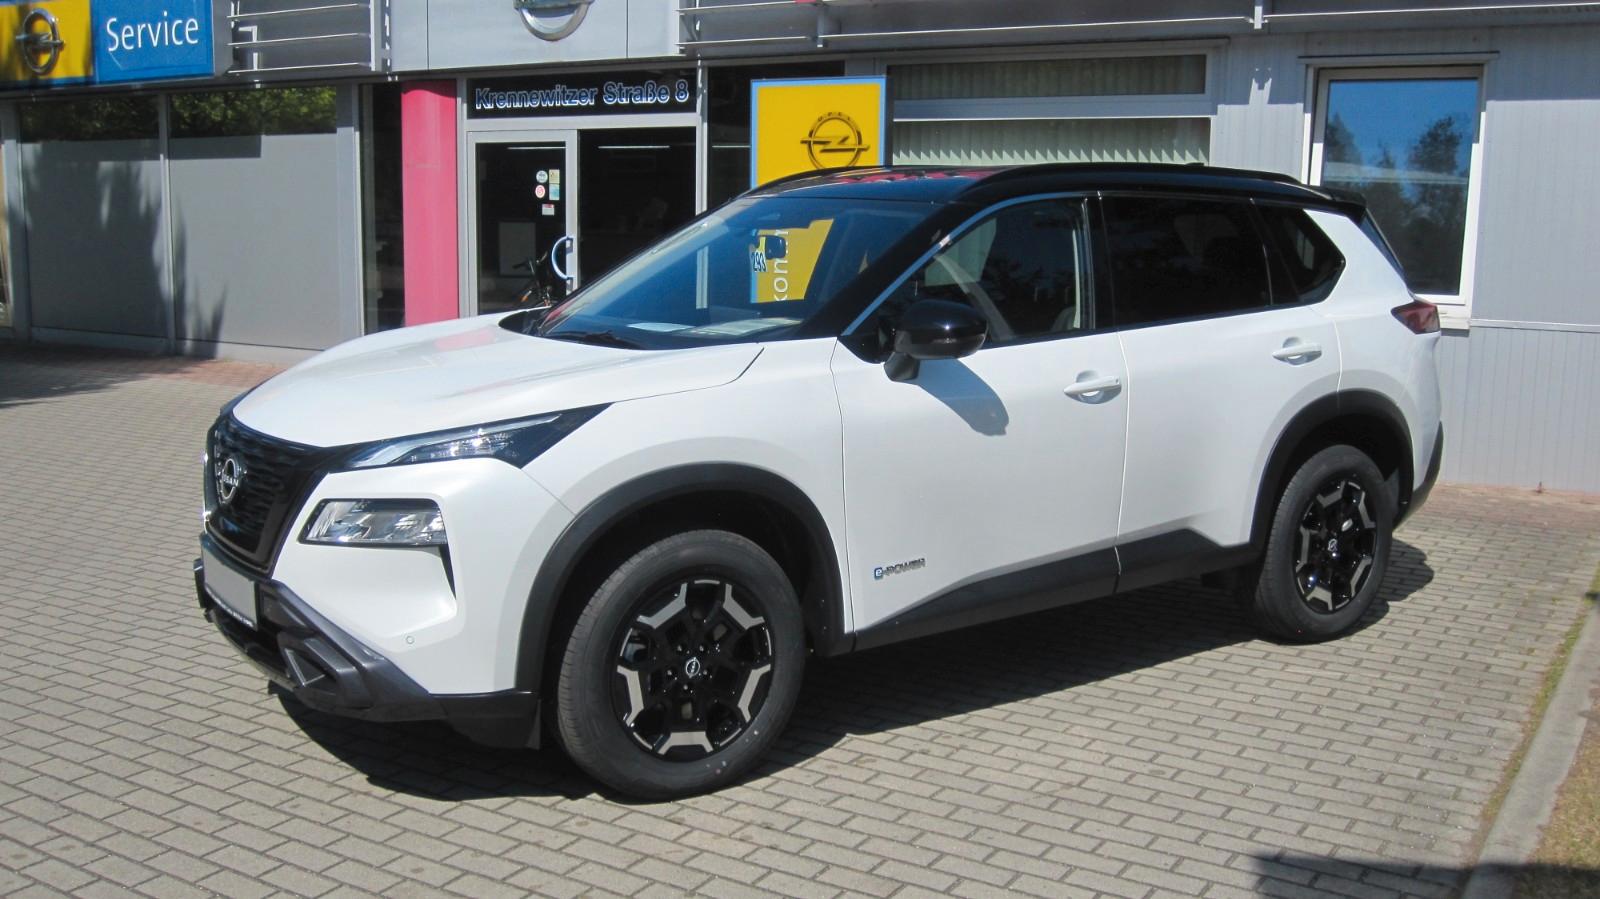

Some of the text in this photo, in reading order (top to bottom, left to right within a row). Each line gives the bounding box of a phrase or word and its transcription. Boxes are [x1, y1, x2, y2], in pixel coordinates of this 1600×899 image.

[106, 11, 199, 52] Service
[475, 79, 689, 109] Krennewitzer Straße 8
